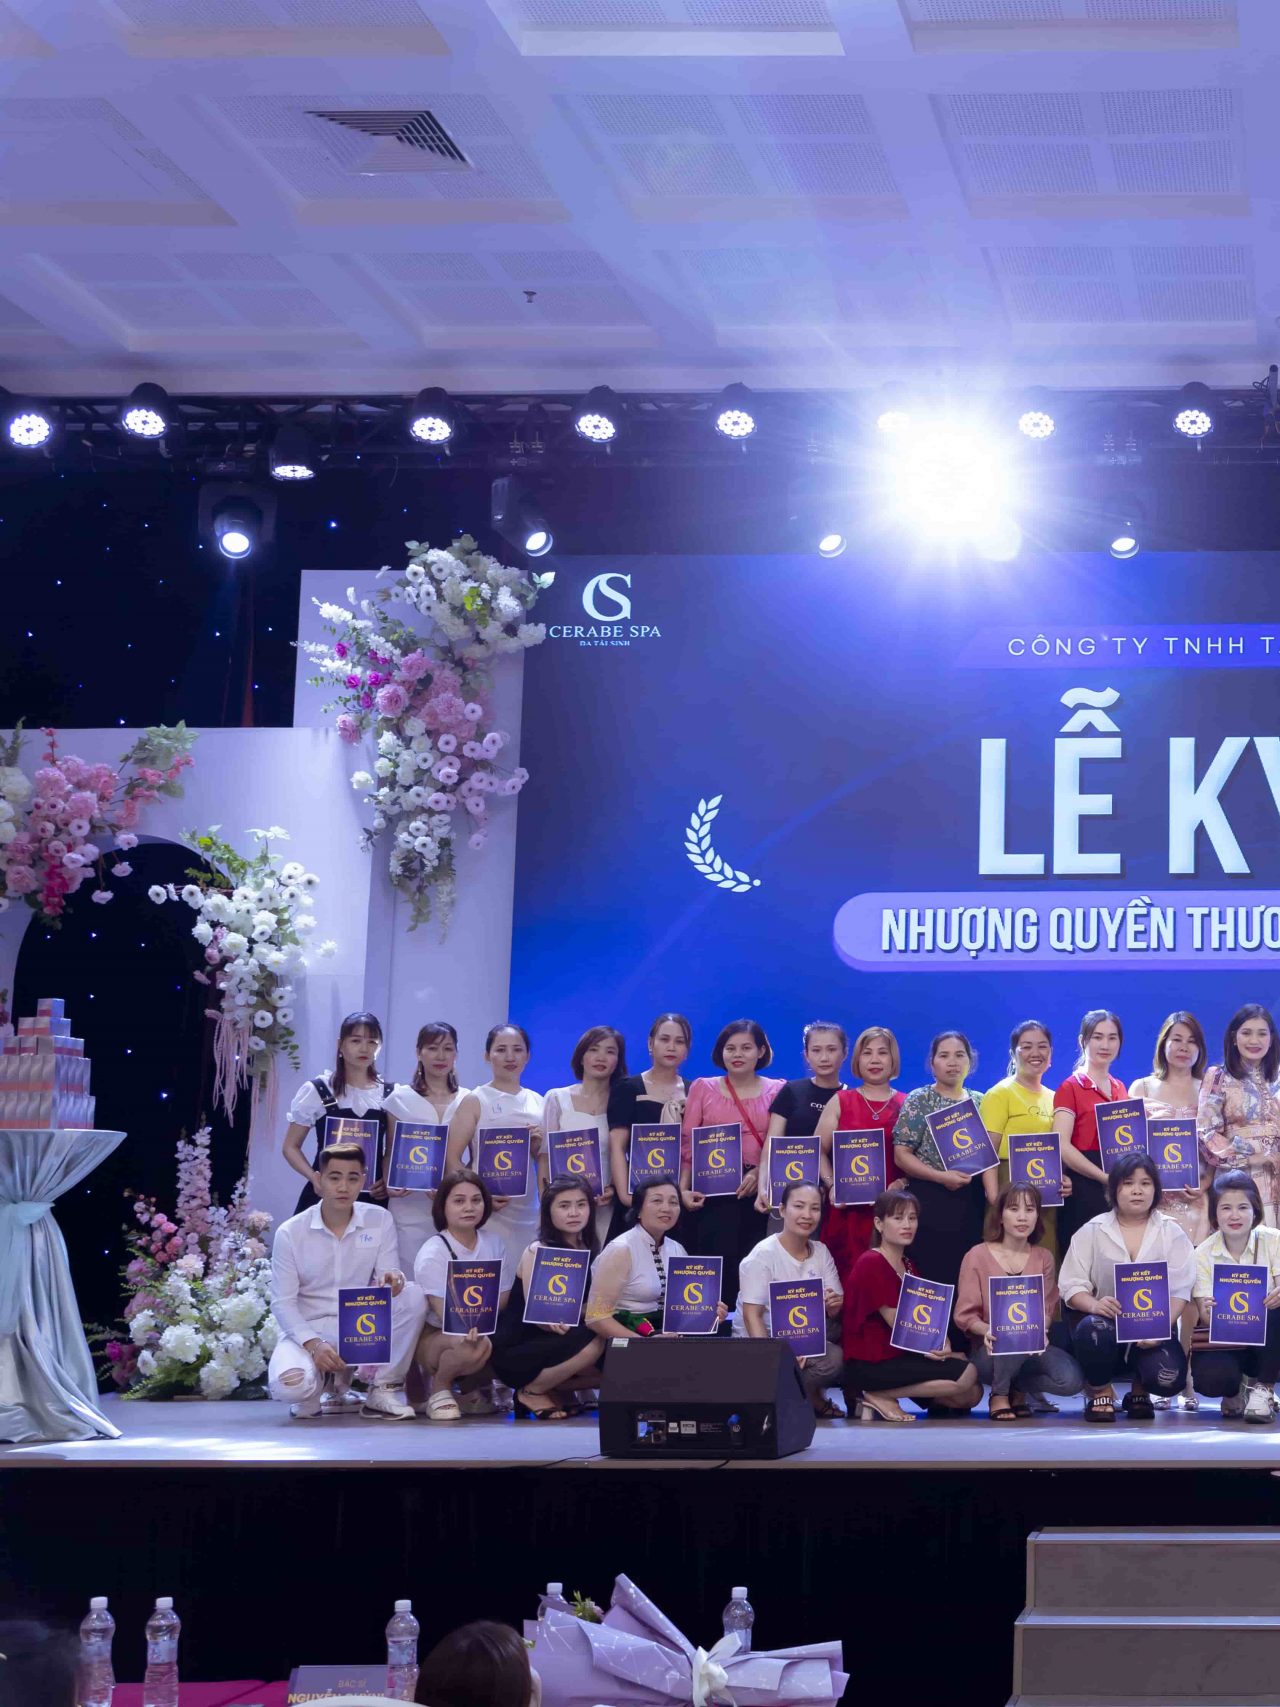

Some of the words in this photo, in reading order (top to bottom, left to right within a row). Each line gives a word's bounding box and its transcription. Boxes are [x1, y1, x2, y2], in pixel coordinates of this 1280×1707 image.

[549, 626, 624, 638] CERABE
[630, 626, 661, 637] SPA
[1008, 634, 1095, 656] CÔNG
[1112, 637, 1148, 655] TY
[1164, 637, 1244, 654] TNHH
[979, 686, 1123, 876] LỄ
[882, 905, 1039, 957] NHƯỢNG
[1049, 896, 1175, 951] QUYỀN
[948, 1147, 974, 1161] CERABE
[974, 1142, 987, 1151] SPA
[1123, 1311, 1150, 1319] CERABE
[997, 1324, 1025, 1332] CERABE
